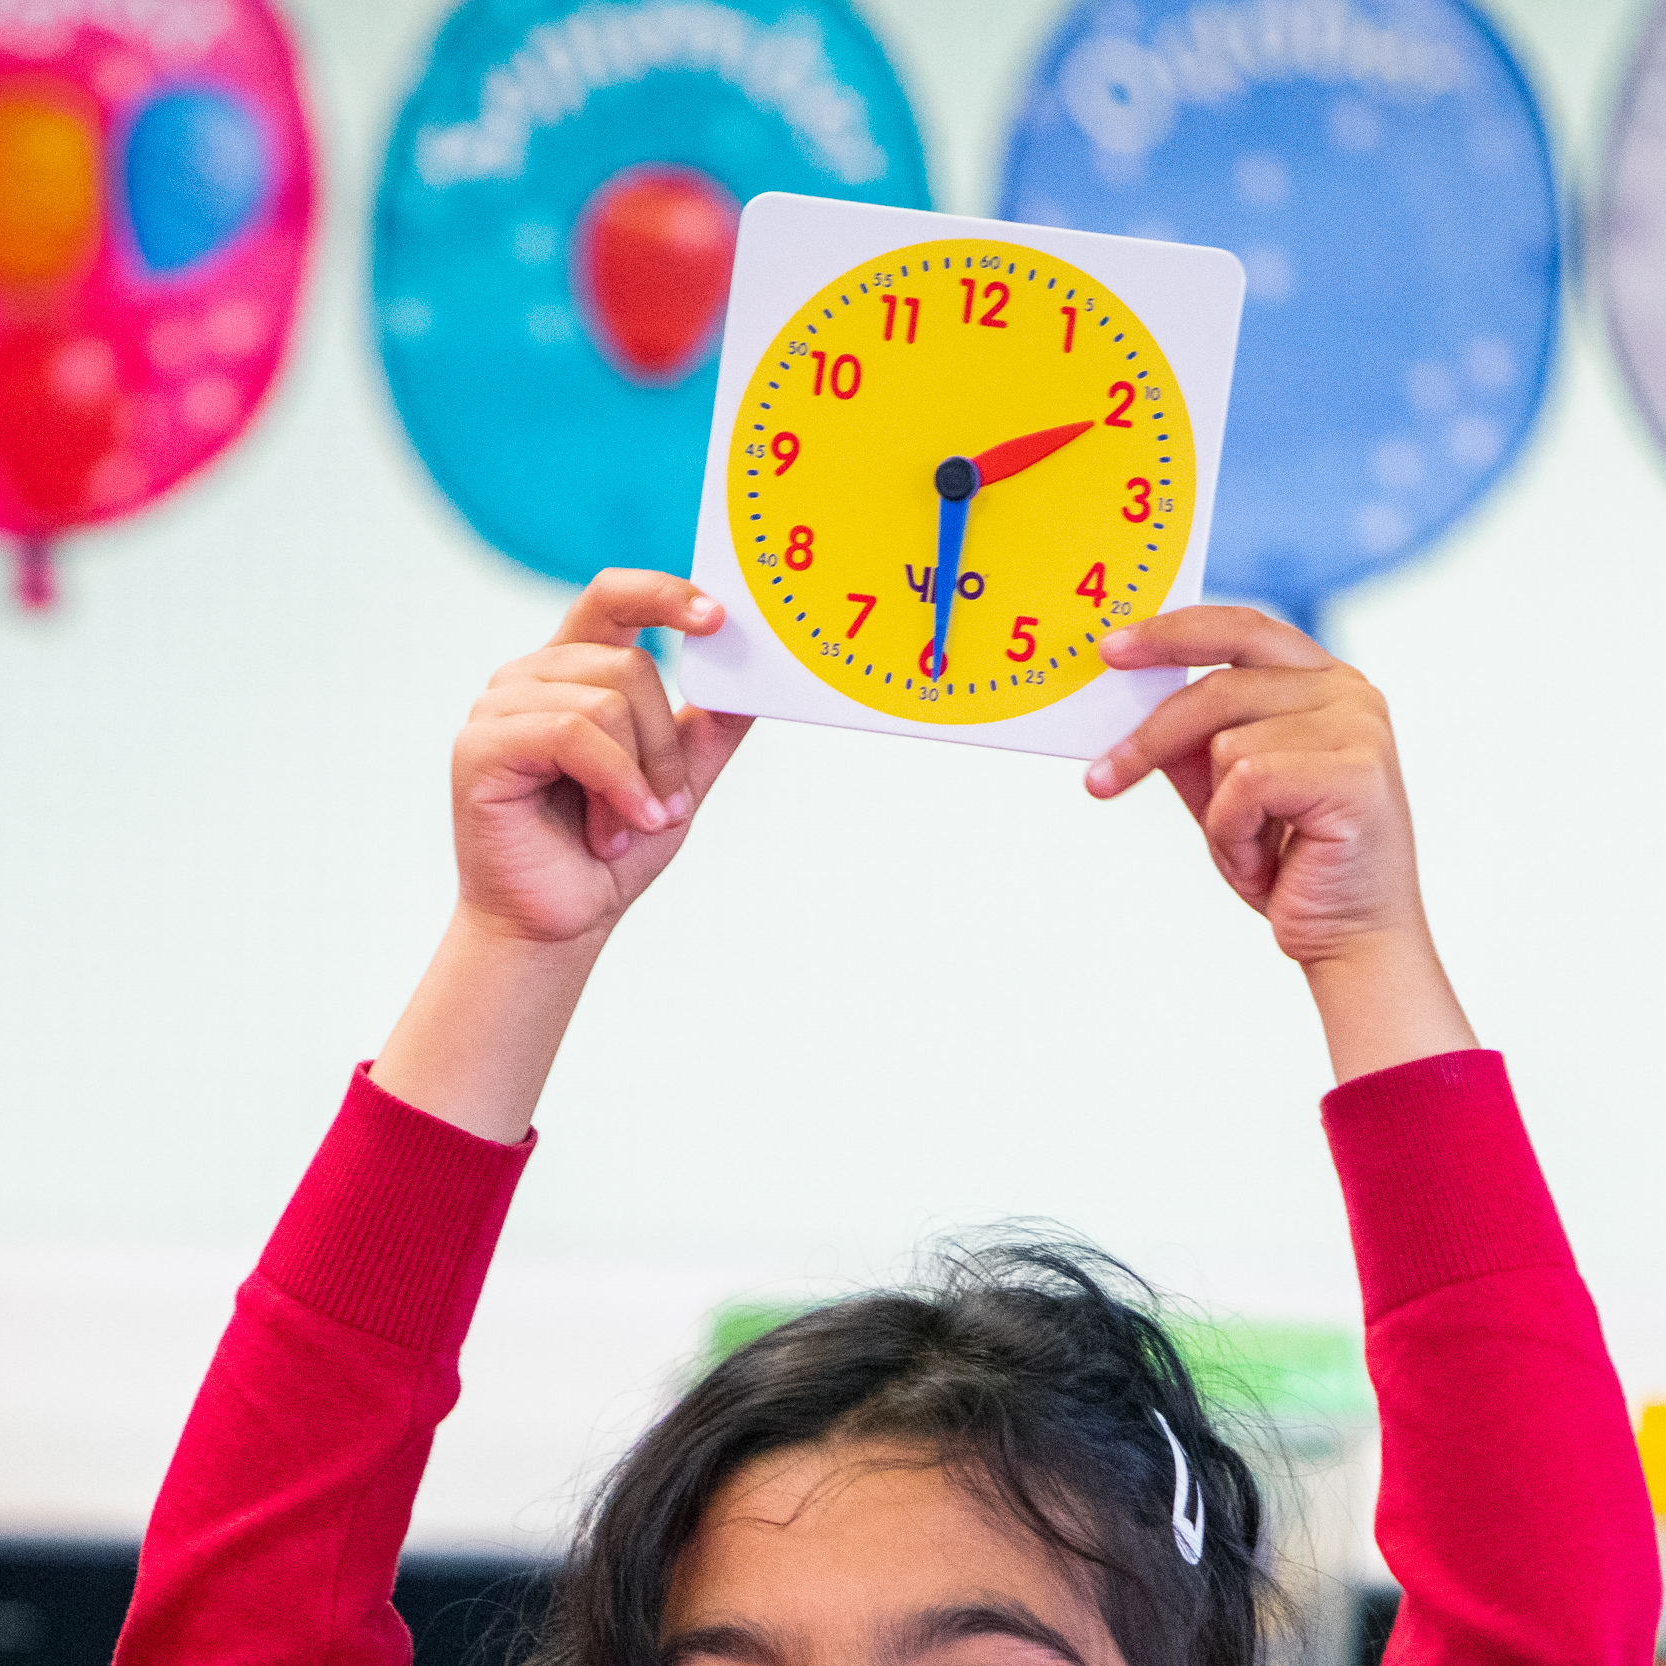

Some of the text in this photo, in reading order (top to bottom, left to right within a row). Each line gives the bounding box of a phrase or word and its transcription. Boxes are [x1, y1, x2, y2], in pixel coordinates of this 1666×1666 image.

[979, 255, 1001, 270] 60
[873, 272, 893, 289] 55
[960, 277, 1011, 329] 12
[1085, 297, 1095, 313] 5
[881, 294, 920, 345] 11
[1060, 305, 1077, 354] 1
[788, 340, 809, 357] 50
[811, 350, 862, 401] 10
[1144, 385, 1161, 402] 10
[1103, 380, 1136, 429] 2
[744, 443, 766, 459] 45
[770, 431, 801, 477] 9
[1121, 476, 1152, 524] 3
[1158, 497, 1174, 514] 15
[784, 524, 815, 572] 8
[756, 552, 778, 568] 40
[1075, 561, 1108, 608] 4
[846, 592, 878, 640] 7
[1110, 600, 1132, 617] 20
[1005, 615, 1039, 663] 5
[820, 641, 841, 658] 35
[1024, 669, 1045, 686] 25
[918, 685, 940, 703] 30
